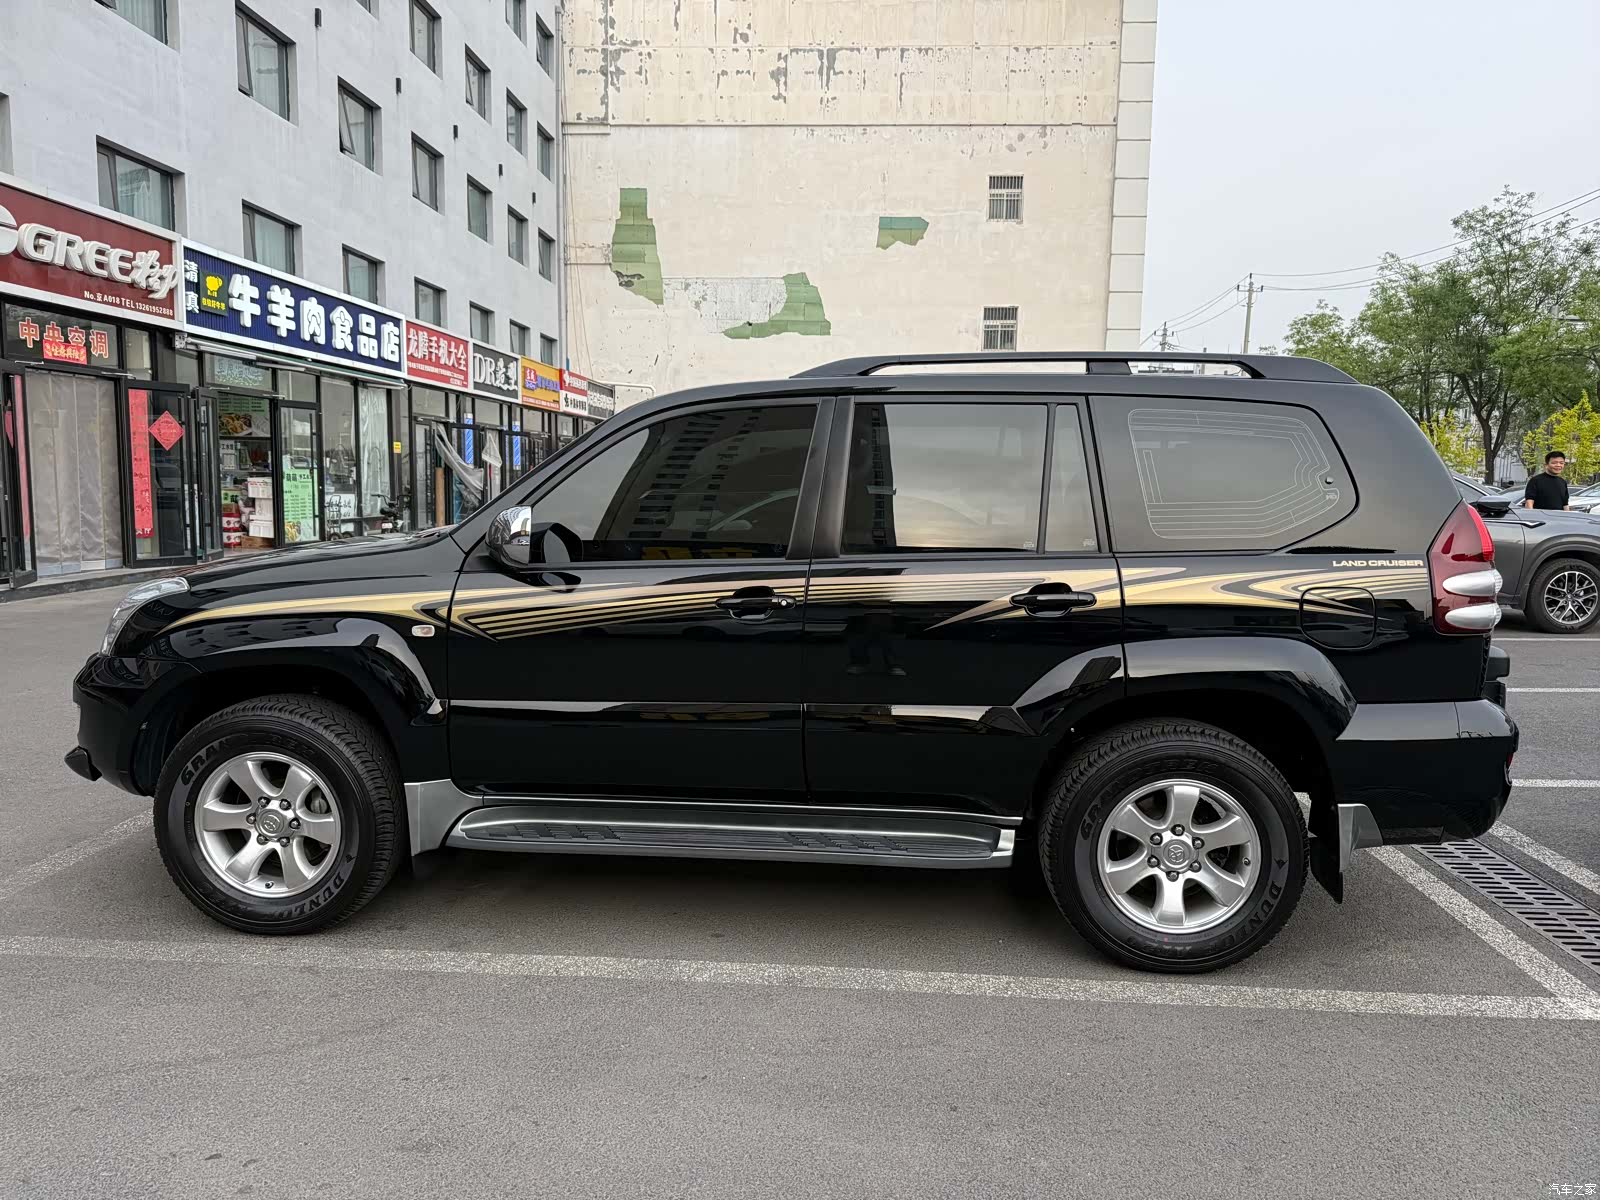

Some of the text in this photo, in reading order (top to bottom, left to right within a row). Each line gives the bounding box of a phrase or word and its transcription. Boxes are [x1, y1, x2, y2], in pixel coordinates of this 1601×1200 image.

[17, 223, 134, 284] GREE
[19, 316, 109, 359] 中央空调
[228, 273, 400, 363] 牛羊肉食品店
